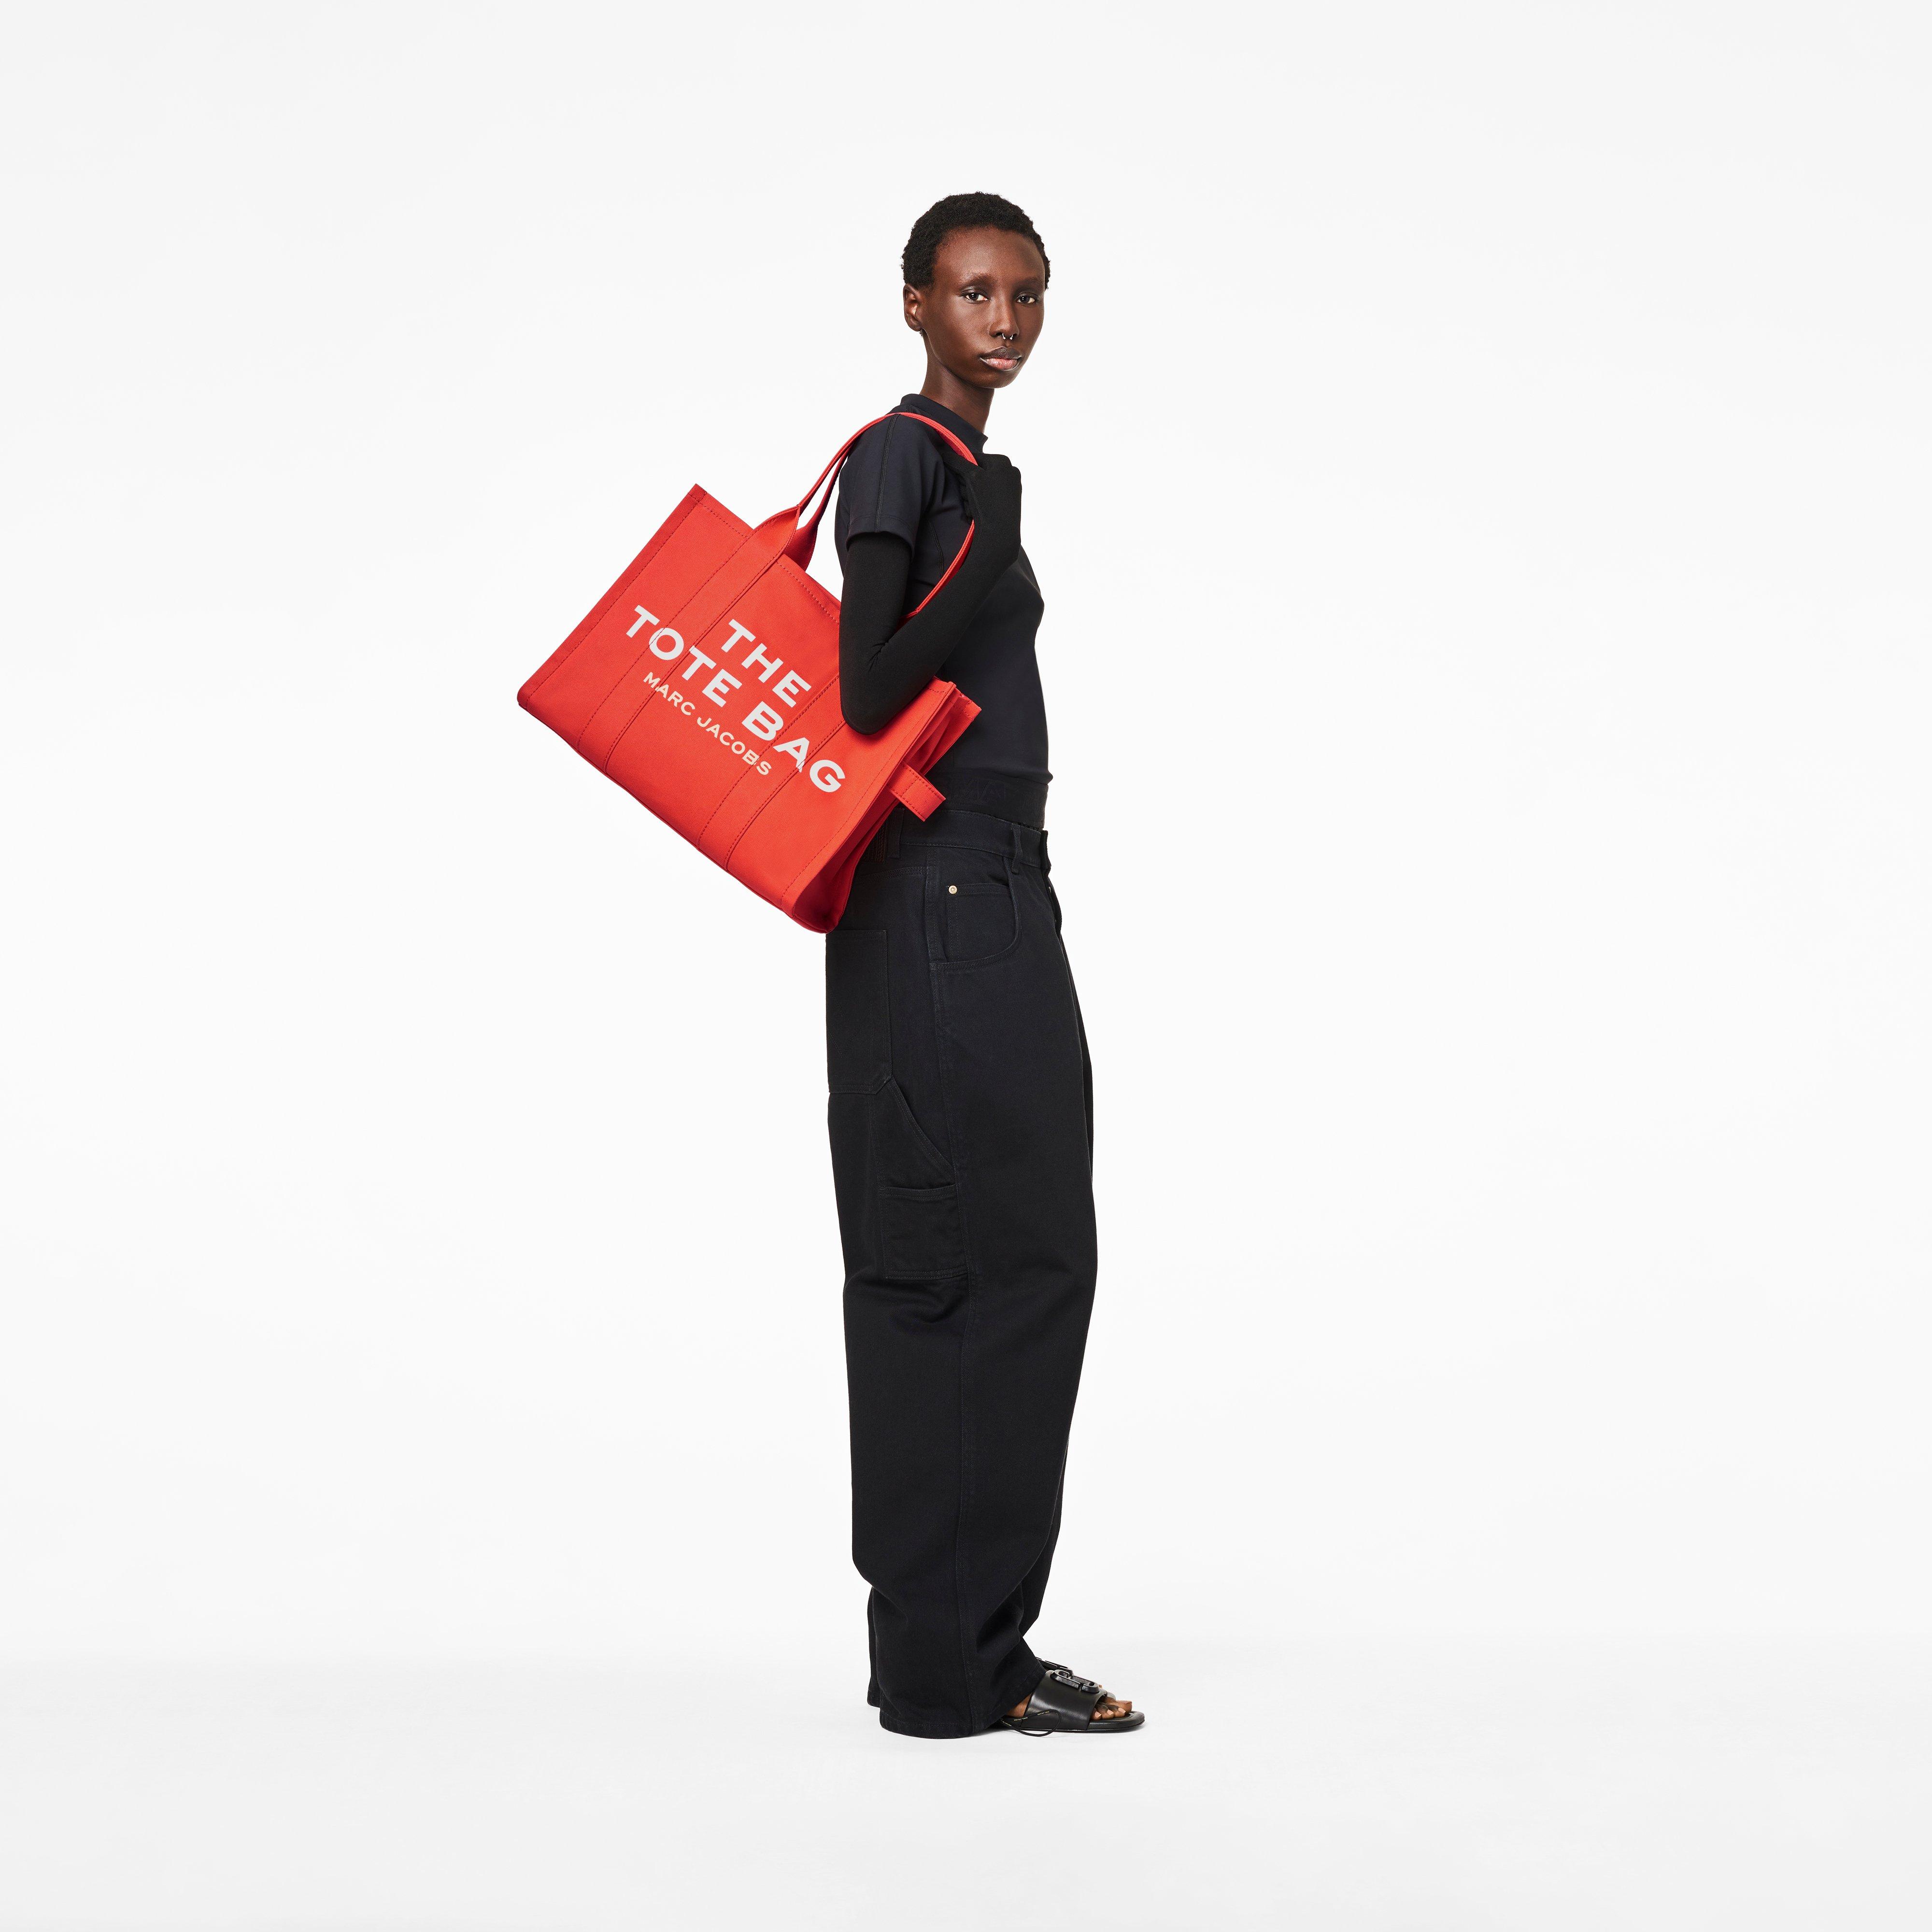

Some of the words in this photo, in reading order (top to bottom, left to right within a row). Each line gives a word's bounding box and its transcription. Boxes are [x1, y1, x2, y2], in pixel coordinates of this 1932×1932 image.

[626, 605, 742, 707] TOTE
[741, 701, 845, 792] BAG
[721, 619, 811, 708] THE
[643, 672, 696, 715] MARC
[697, 717, 772, 775] JACOBS
